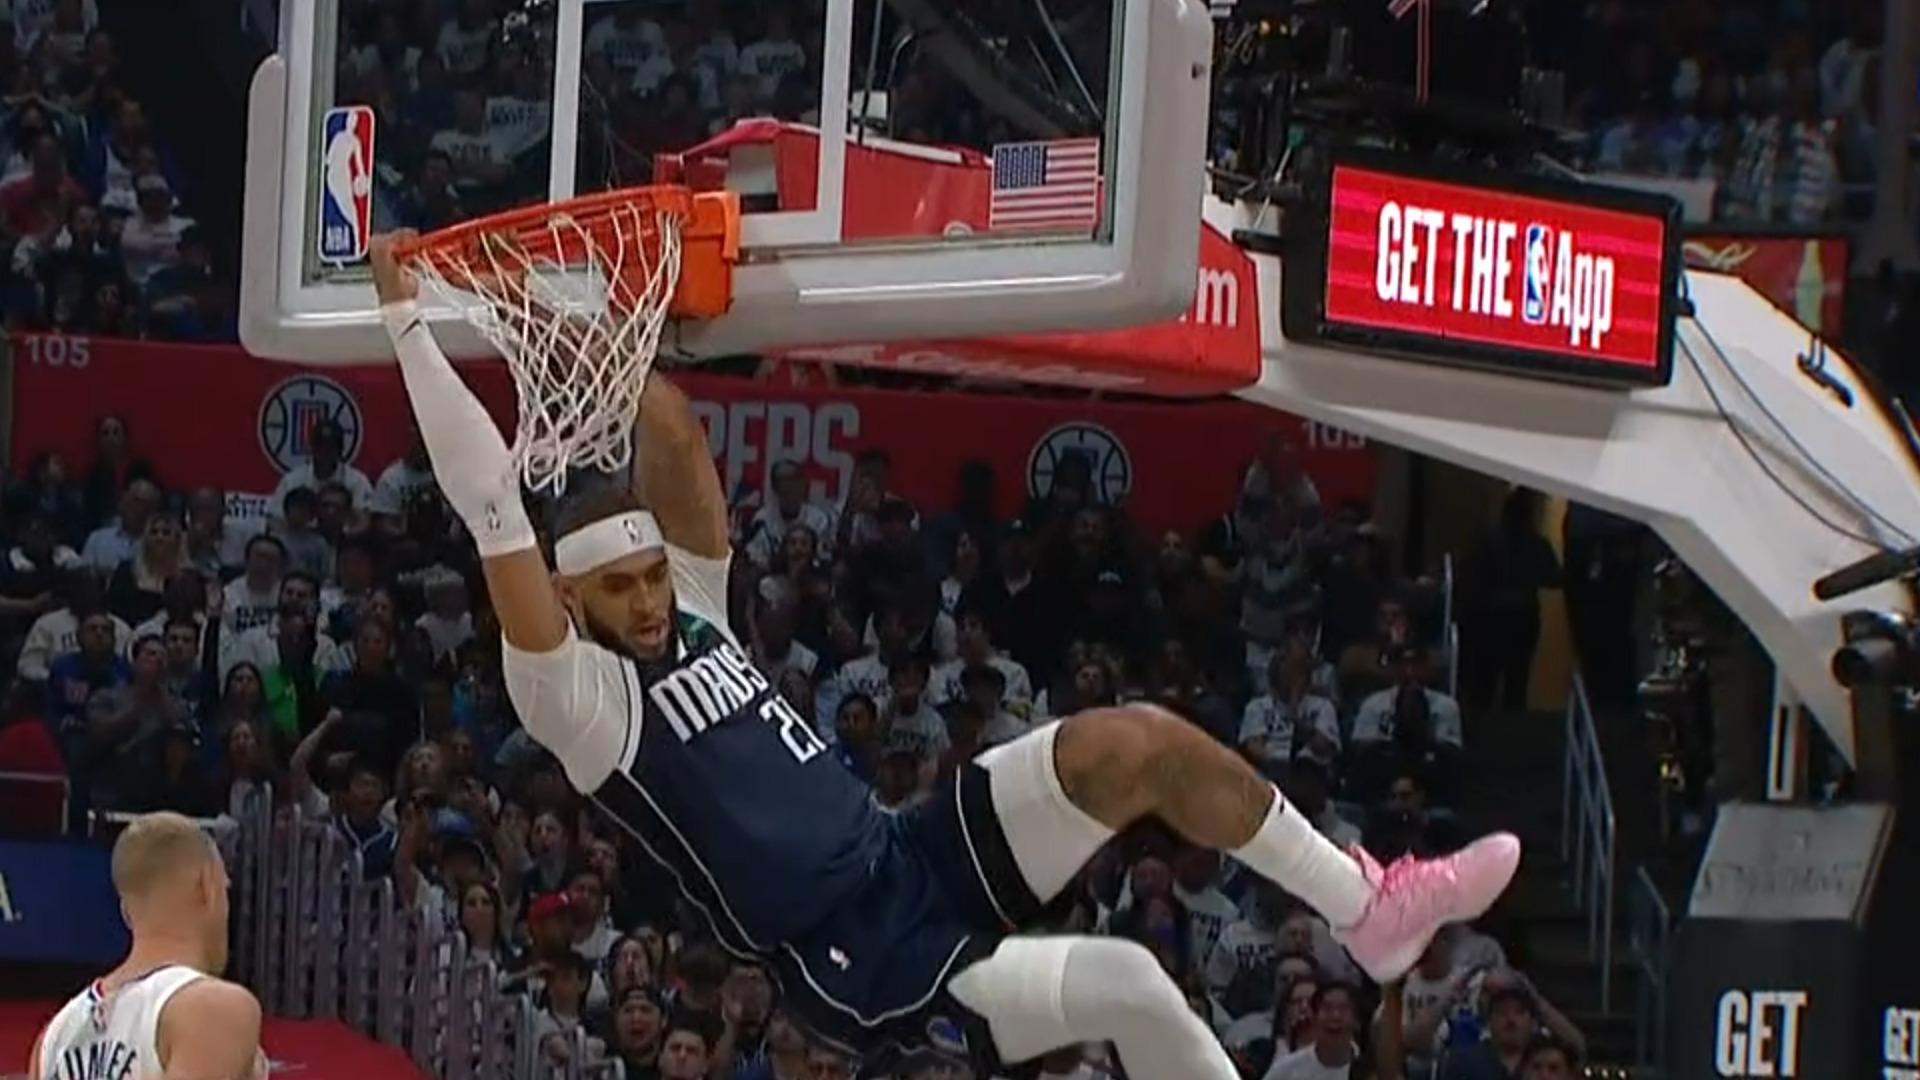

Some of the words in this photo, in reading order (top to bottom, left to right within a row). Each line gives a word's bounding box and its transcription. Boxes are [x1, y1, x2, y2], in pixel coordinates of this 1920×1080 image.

[325, 223, 351, 253] NBA
[1376, 201, 1445, 307] GET
[1451, 213, 1518, 318] THE
[1550, 230, 1615, 350] App
[25, 336, 90, 367] 105
[648, 642, 769, 743] MAVS
[759, 694, 828, 764] 21
[1715, 989, 1808, 1077] GET
